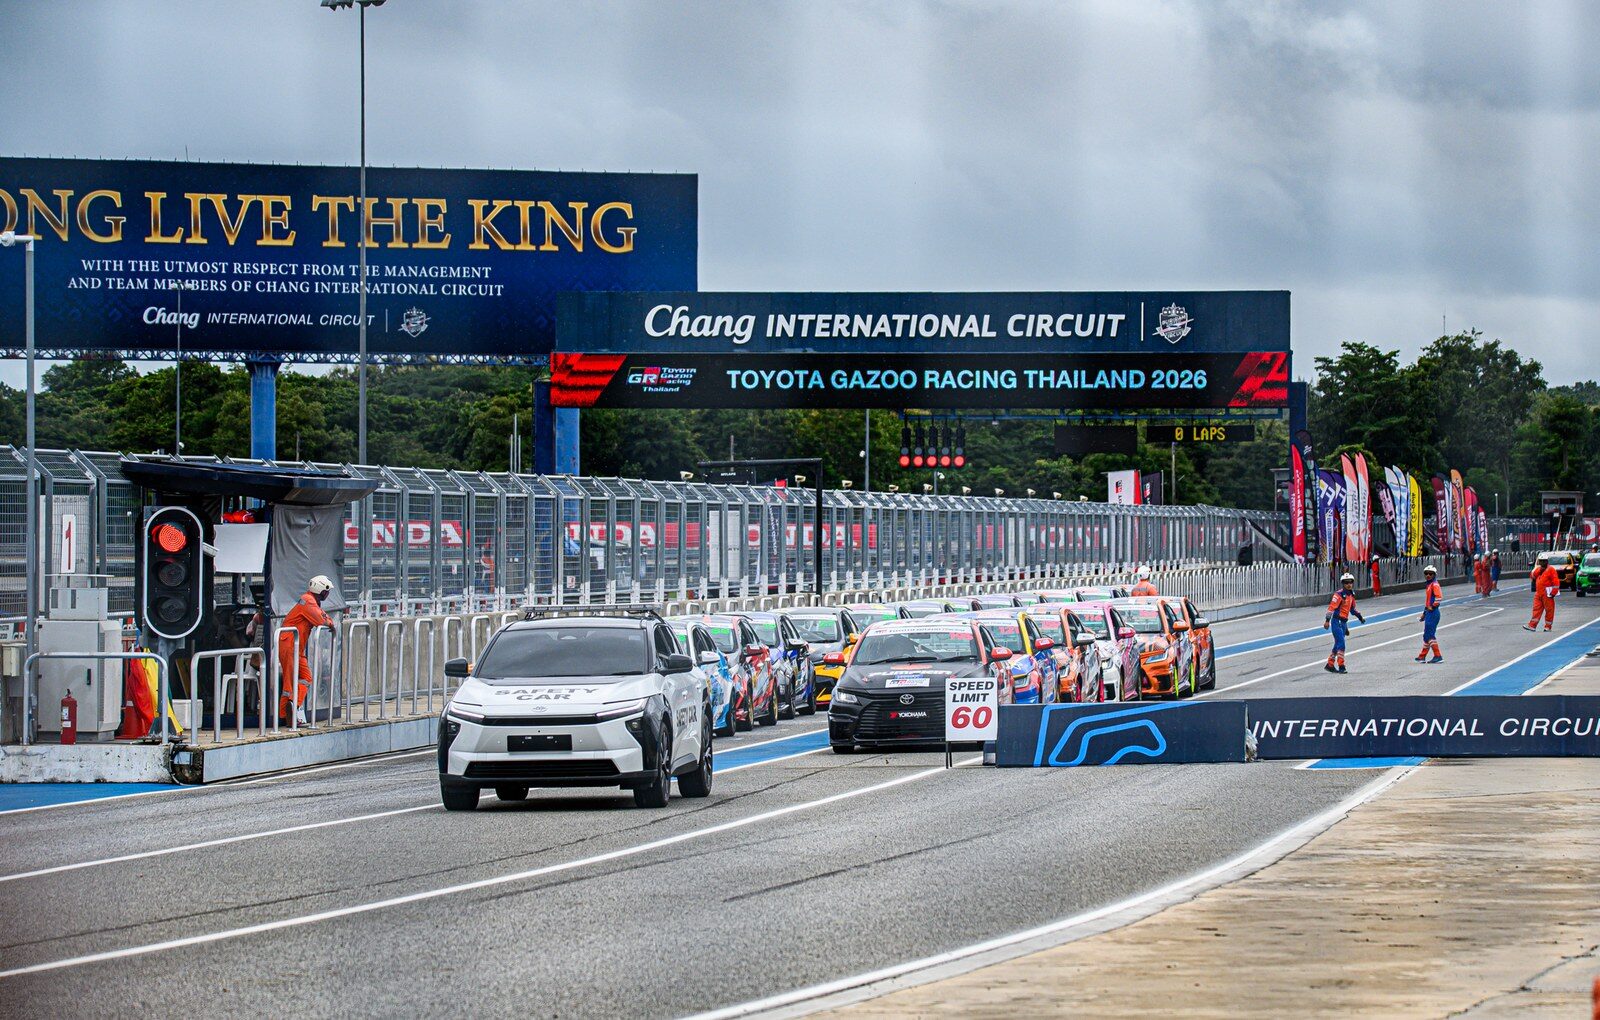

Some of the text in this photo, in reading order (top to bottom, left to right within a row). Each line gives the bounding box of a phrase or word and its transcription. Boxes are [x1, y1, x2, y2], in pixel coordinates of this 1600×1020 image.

[145, 191, 296, 246] LIVE
[313, 195, 450, 250] THE
[467, 199, 636, 254] KING
[81, 259, 124, 273] WITH
[128, 260, 160, 273] THE
[164, 261, 229, 274] UTMOST
[233, 263, 298, 276] RESPECT
[303, 264, 345, 276] FROM
[384, 266, 491, 279] MANAGEMENT
[68, 277, 101, 290] AND
[106, 277, 149, 290] TEAM
[231, 280, 252, 293] OF
[257, 281, 310, 294] CHANG
[314, 282, 437, 296] INTERNATIONAL
[441, 284, 505, 297] CIRCUIT
[143, 305, 376, 330] Chang INTERNATIONAL CIRCUT
[645, 304, 1127, 345] Chang INTERNATIONAL CIRCUIT
[628, 373, 657, 384] GR
[726, 369, 1208, 390] TOYOTA GAZOO RACING THAILAND 2026
[1175, 427, 1226, 441] 0 LAPS
[949, 681, 995, 691] SPEED
[952, 693, 990, 703] LIMIT
[898, 711, 927, 719] YOKOHAMA
[951, 706, 993, 729] 60
[1252, 718, 1485, 738] INTERNATIONAL
